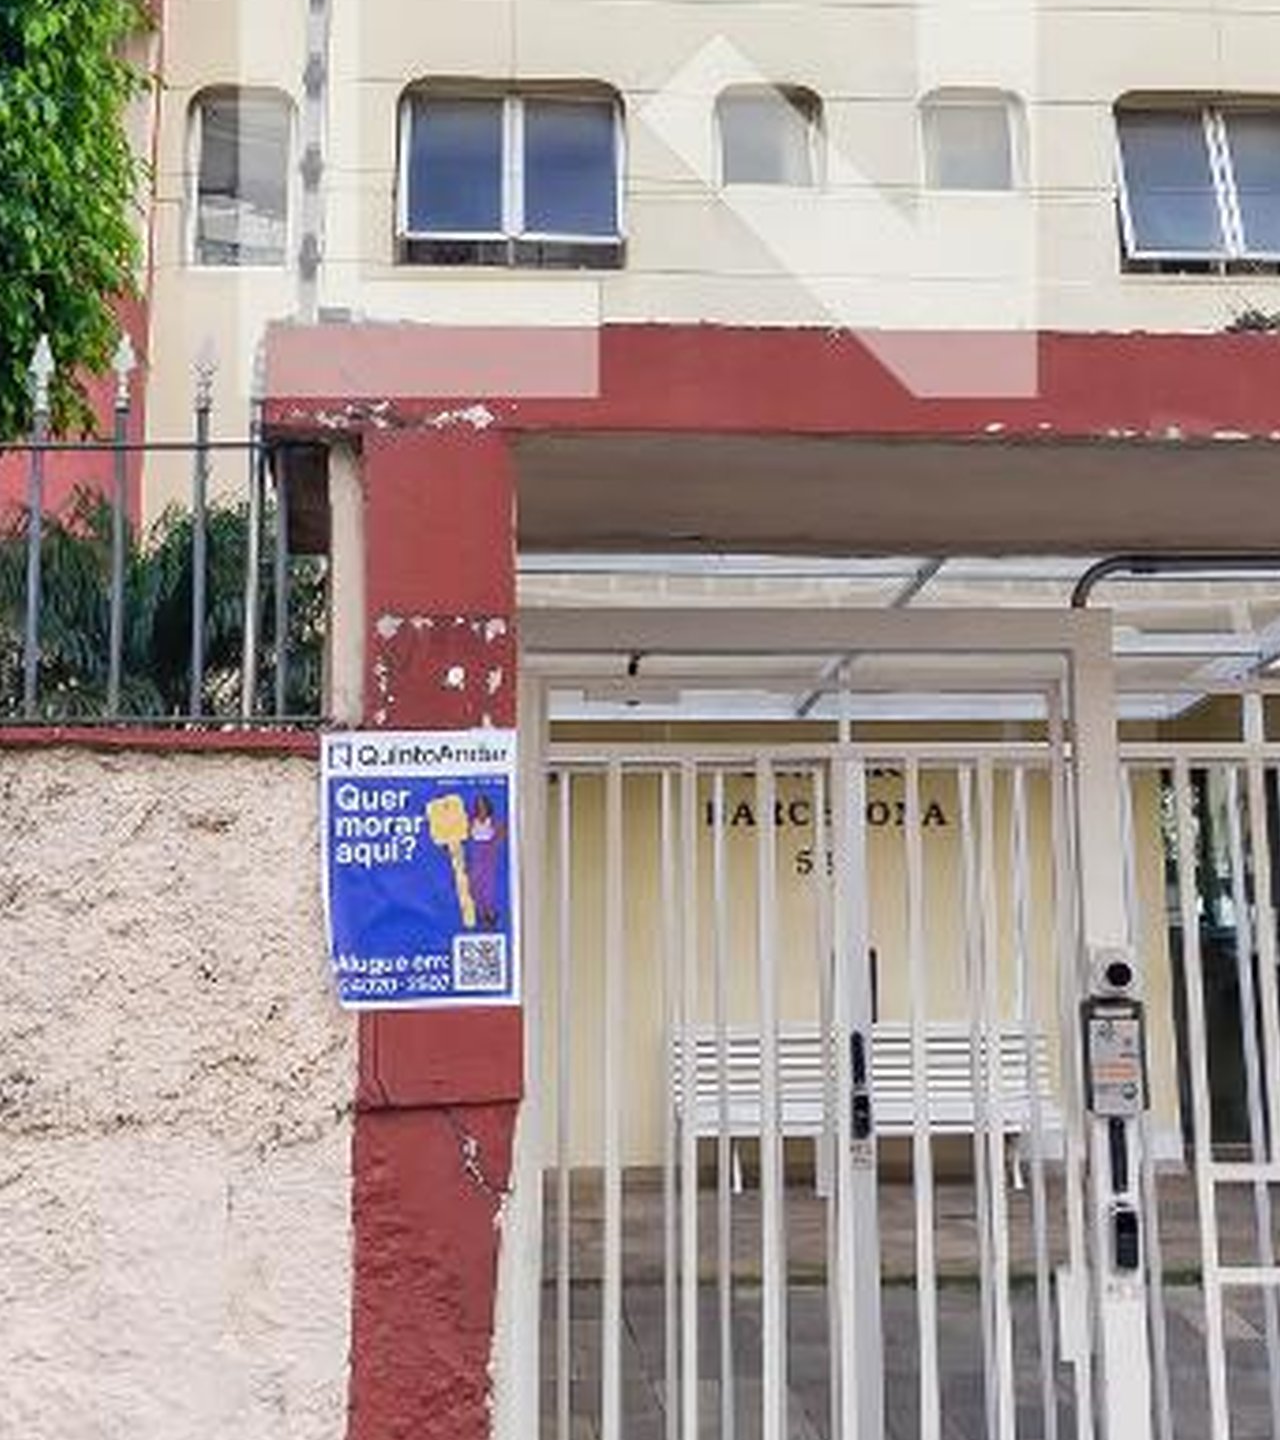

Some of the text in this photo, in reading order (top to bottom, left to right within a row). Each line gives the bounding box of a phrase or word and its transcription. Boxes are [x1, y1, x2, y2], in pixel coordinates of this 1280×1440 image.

[335, 783, 411, 812] Quer
[335, 815, 424, 837] morar
[335, 836, 417, 868] aqui?
